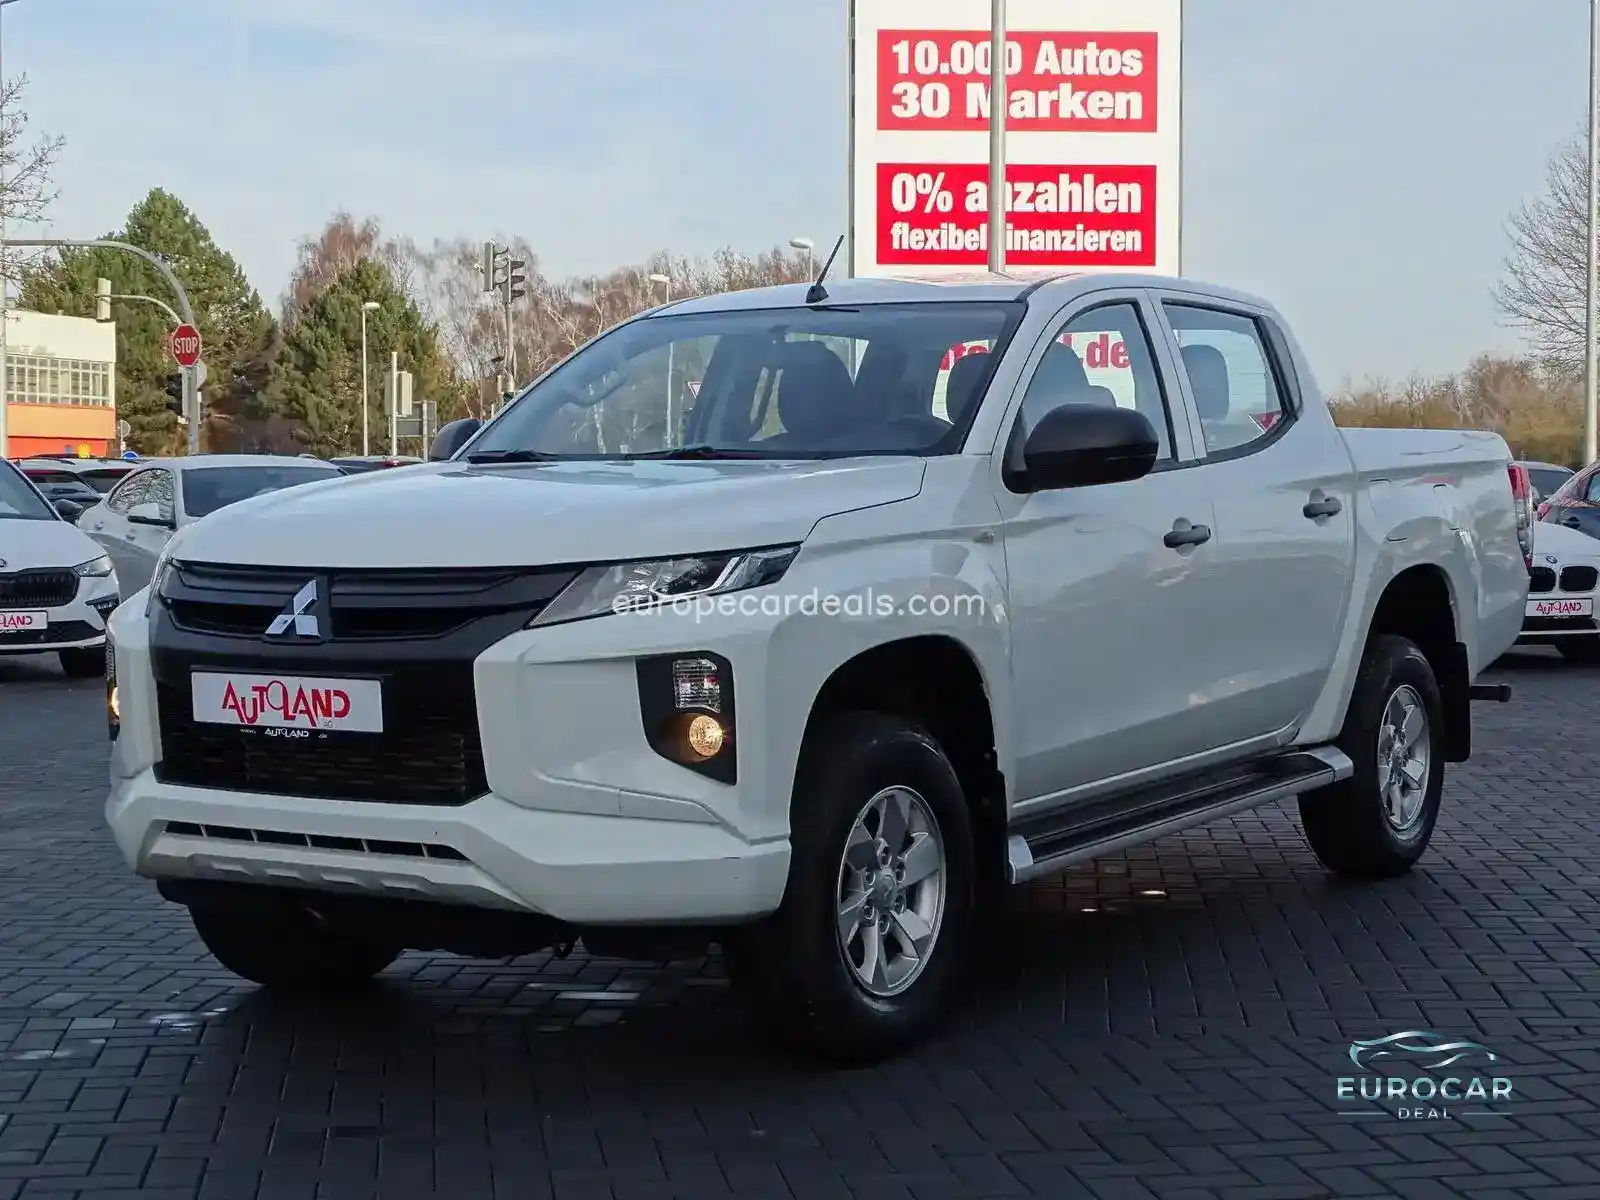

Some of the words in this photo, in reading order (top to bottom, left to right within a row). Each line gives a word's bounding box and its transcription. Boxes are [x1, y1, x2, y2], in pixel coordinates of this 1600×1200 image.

[891, 40, 1023, 76] 10.000
[1033, 40, 1143, 77] Autos
[891, 82, 950, 119] 30
[891, 171, 954, 214] 0%
[891, 222, 988, 251] flexibel
[1005, 223, 1142, 252] inanzieren
[174, 336, 198, 354] STOP
[222, 679, 351, 728] AUTOLAND
